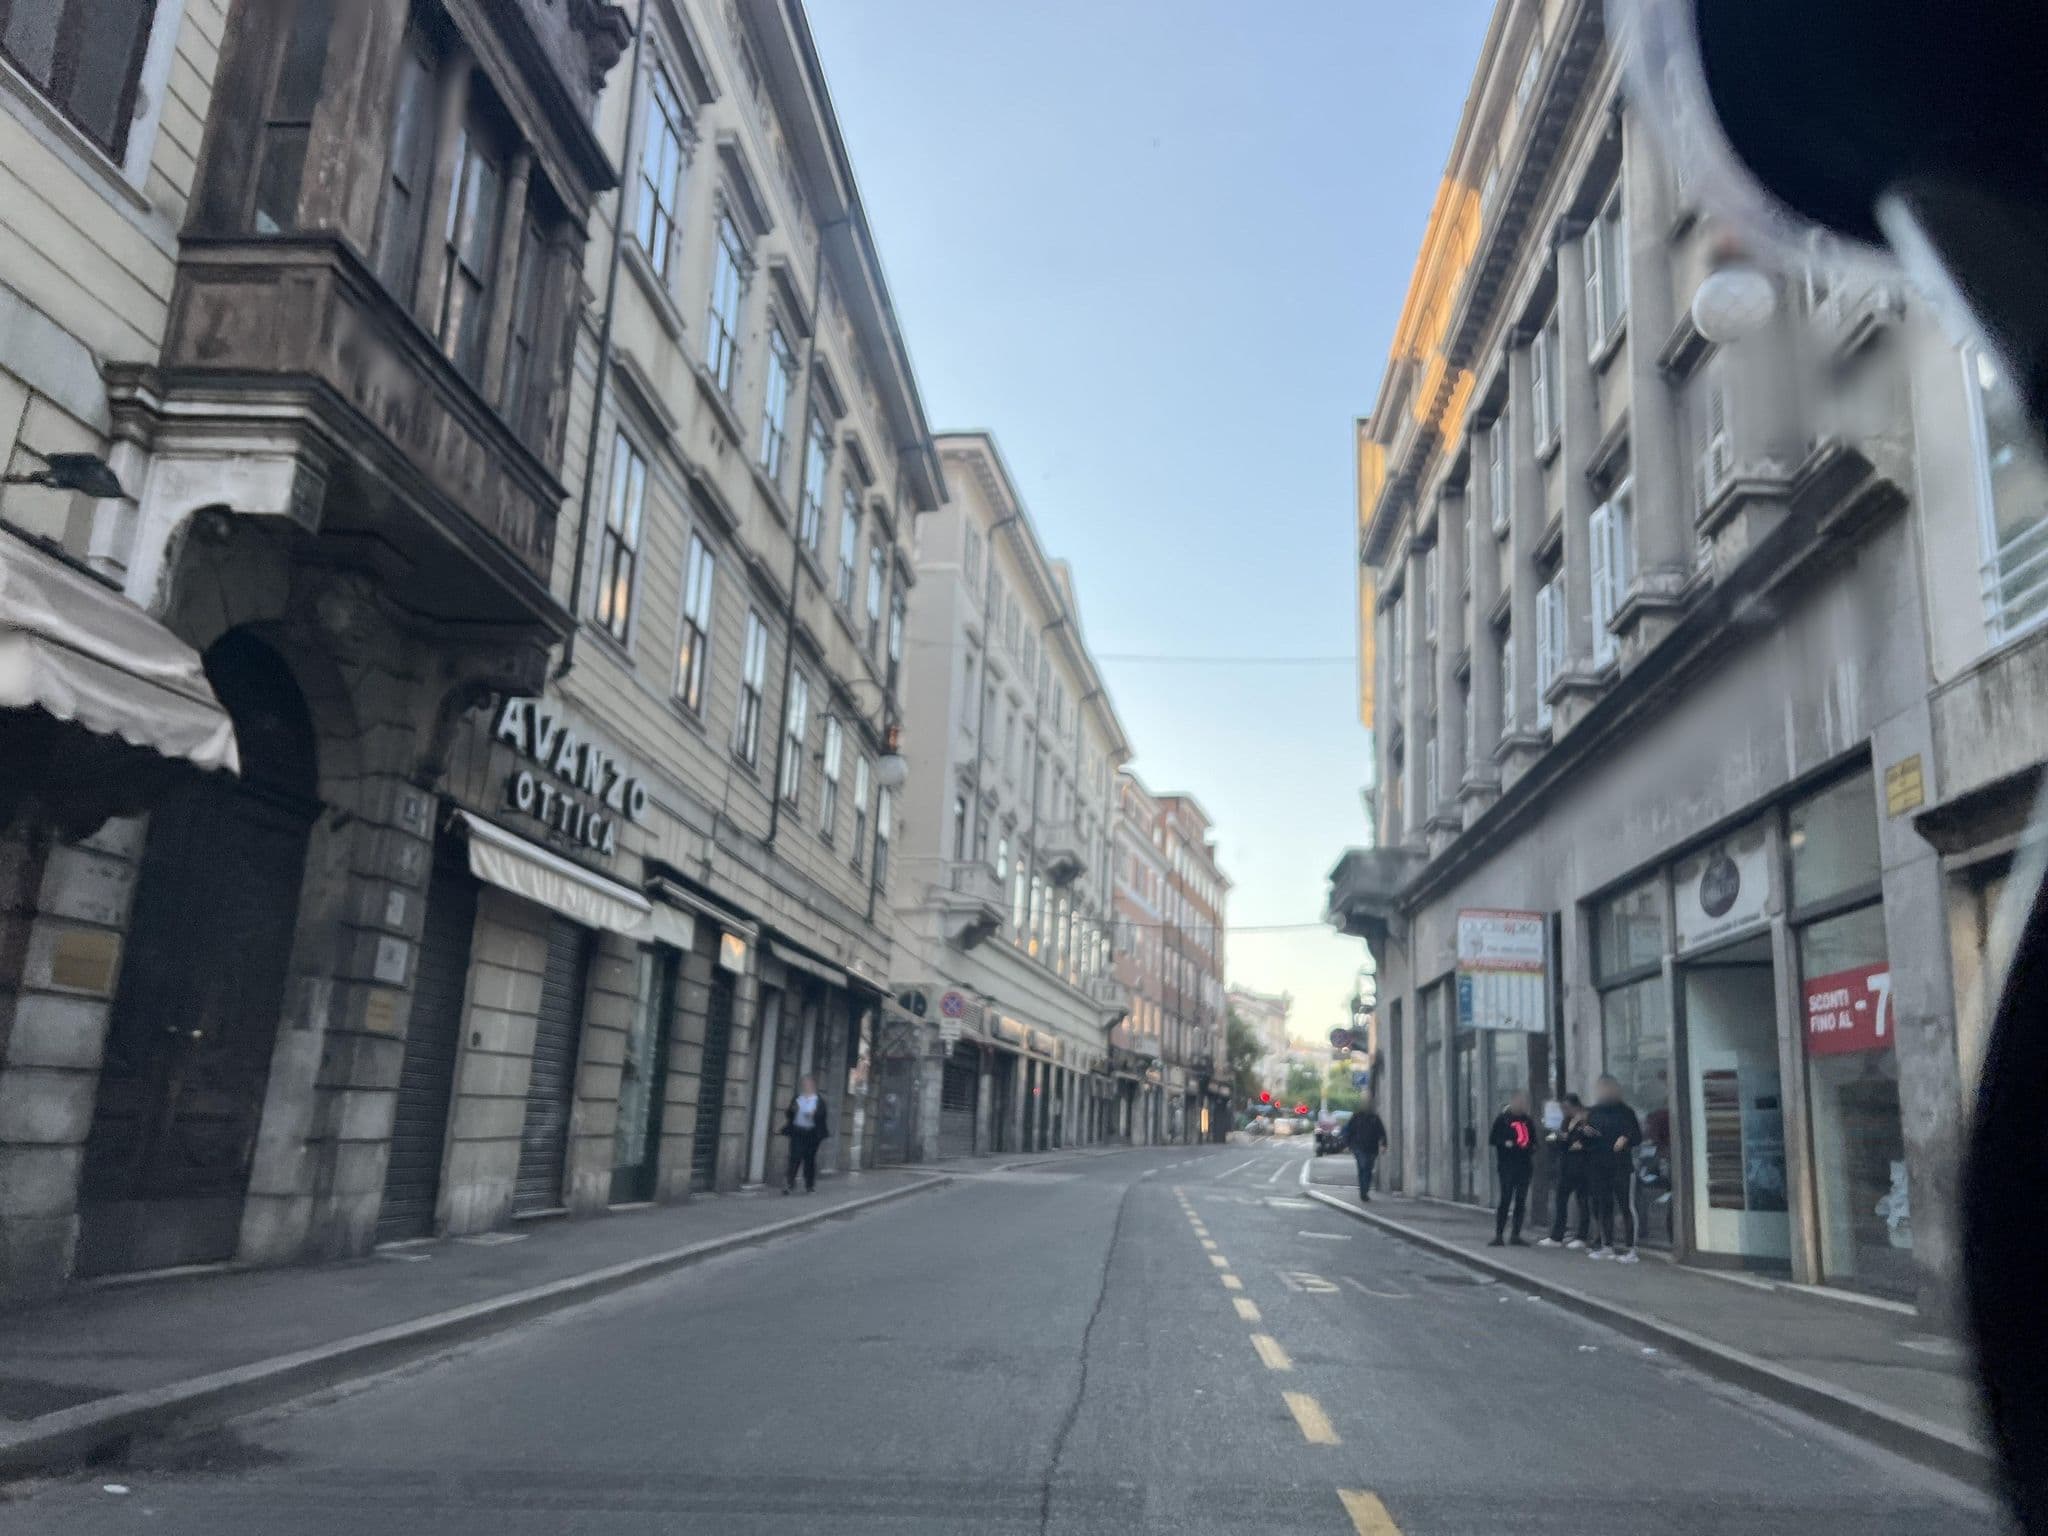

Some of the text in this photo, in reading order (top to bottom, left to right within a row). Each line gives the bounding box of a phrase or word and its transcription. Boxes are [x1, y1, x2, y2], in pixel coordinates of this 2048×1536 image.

[498, 696, 648, 820] AVANZO
[517, 771, 616, 856] OTTICA
[1811, 1012, 1836, 1032] FINO
